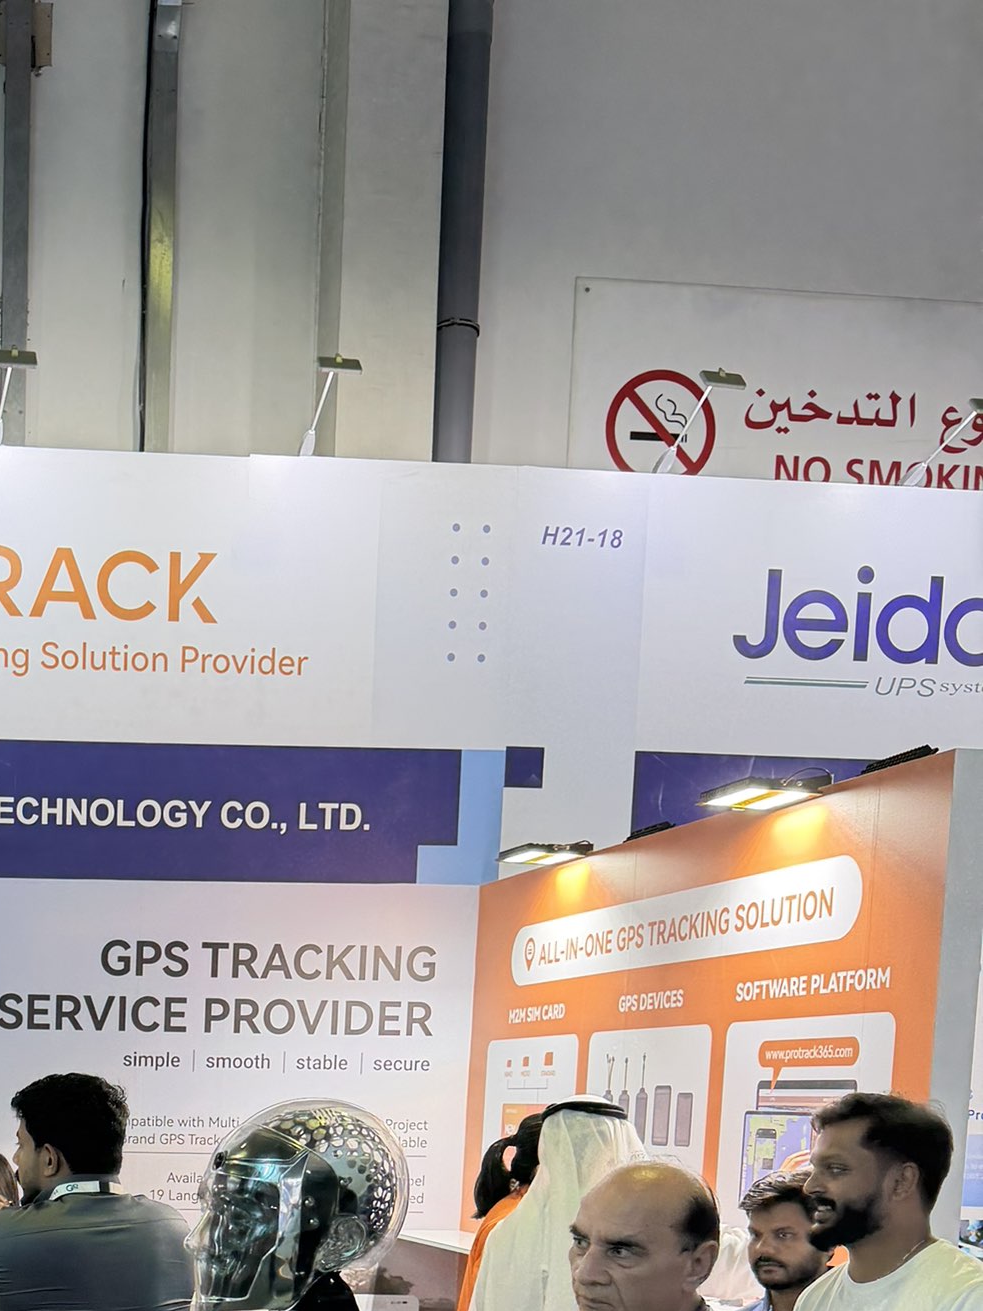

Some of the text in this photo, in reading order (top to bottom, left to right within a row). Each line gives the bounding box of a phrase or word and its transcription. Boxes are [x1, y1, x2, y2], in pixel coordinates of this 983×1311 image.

[744, 388, 916, 434] التدخين
[774, 454, 831, 482] NO
[541, 526, 623, 549] H21-18
[40, 641, 169, 673] Solution
[181, 645, 309, 676] Provider
[875, 676, 936, 698] UPS
[220, 800, 288, 835] CO.,
[298, 802, 370, 831] LTD.
[538, 887, 835, 966] ALL-IN-ONE GPS TRACKING SOLUTION
[100, 939, 437, 982] GPS TRACKING
[735, 966, 891, 1002] SOFTWARE PLATFORM
[618, 989, 684, 1013] GPS DEVICES
[204, 998, 433, 1036] PROVIDER
[508, 1003, 565, 1024] M2M SIM CARD
[123, 1052, 180, 1071] simple
[206, 1053, 271, 1069] smooth
[296, 1054, 348, 1070] stable
[373, 1057, 431, 1072] secure
[765, 1045, 853, 1063] www.protrack365.com
[127, 1116, 174, 1129] patible
[177, 1116, 204, 1128] with
[385, 1119, 428, 1133] Project
[159, 1133, 185, 1145] GPS
[188, 1134, 220, 1146] Track
[399, 1137, 427, 1148] lable
[167, 1172, 204, 1183] Availa
[149, 1189, 200, 1204] 19 Lang
